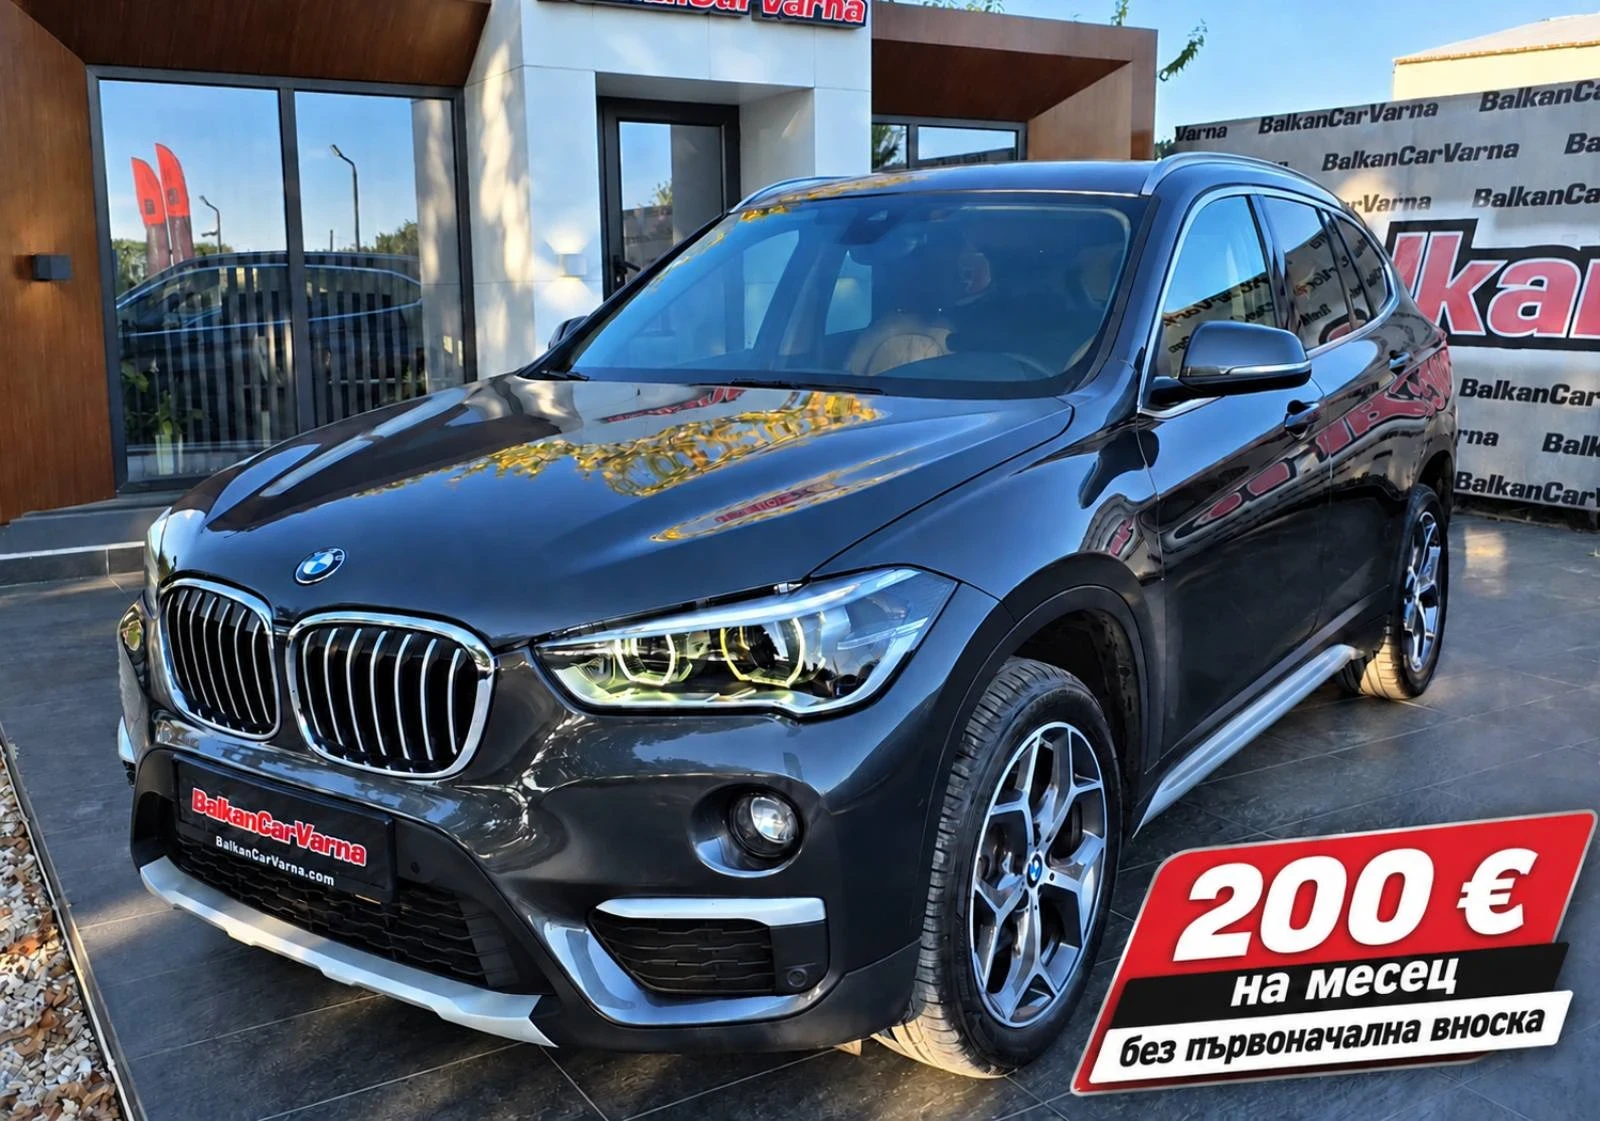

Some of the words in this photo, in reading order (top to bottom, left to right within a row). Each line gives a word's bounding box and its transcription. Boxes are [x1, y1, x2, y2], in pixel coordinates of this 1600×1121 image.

[1175, 125, 1228, 141] Varna
[1258, 102, 1439, 135] BalkanCarVarna
[1322, 142, 1520, 171] BalkanCarVarna
[1472, 182, 1600, 209] BalkanCa
[1458, 378, 1600, 406] BalkanCar
[1454, 470, 1600, 508] BalkanCar
[192, 787, 367, 867] BalkanCarVarna
[215, 835, 335, 886] BalkanCarVarna.com
